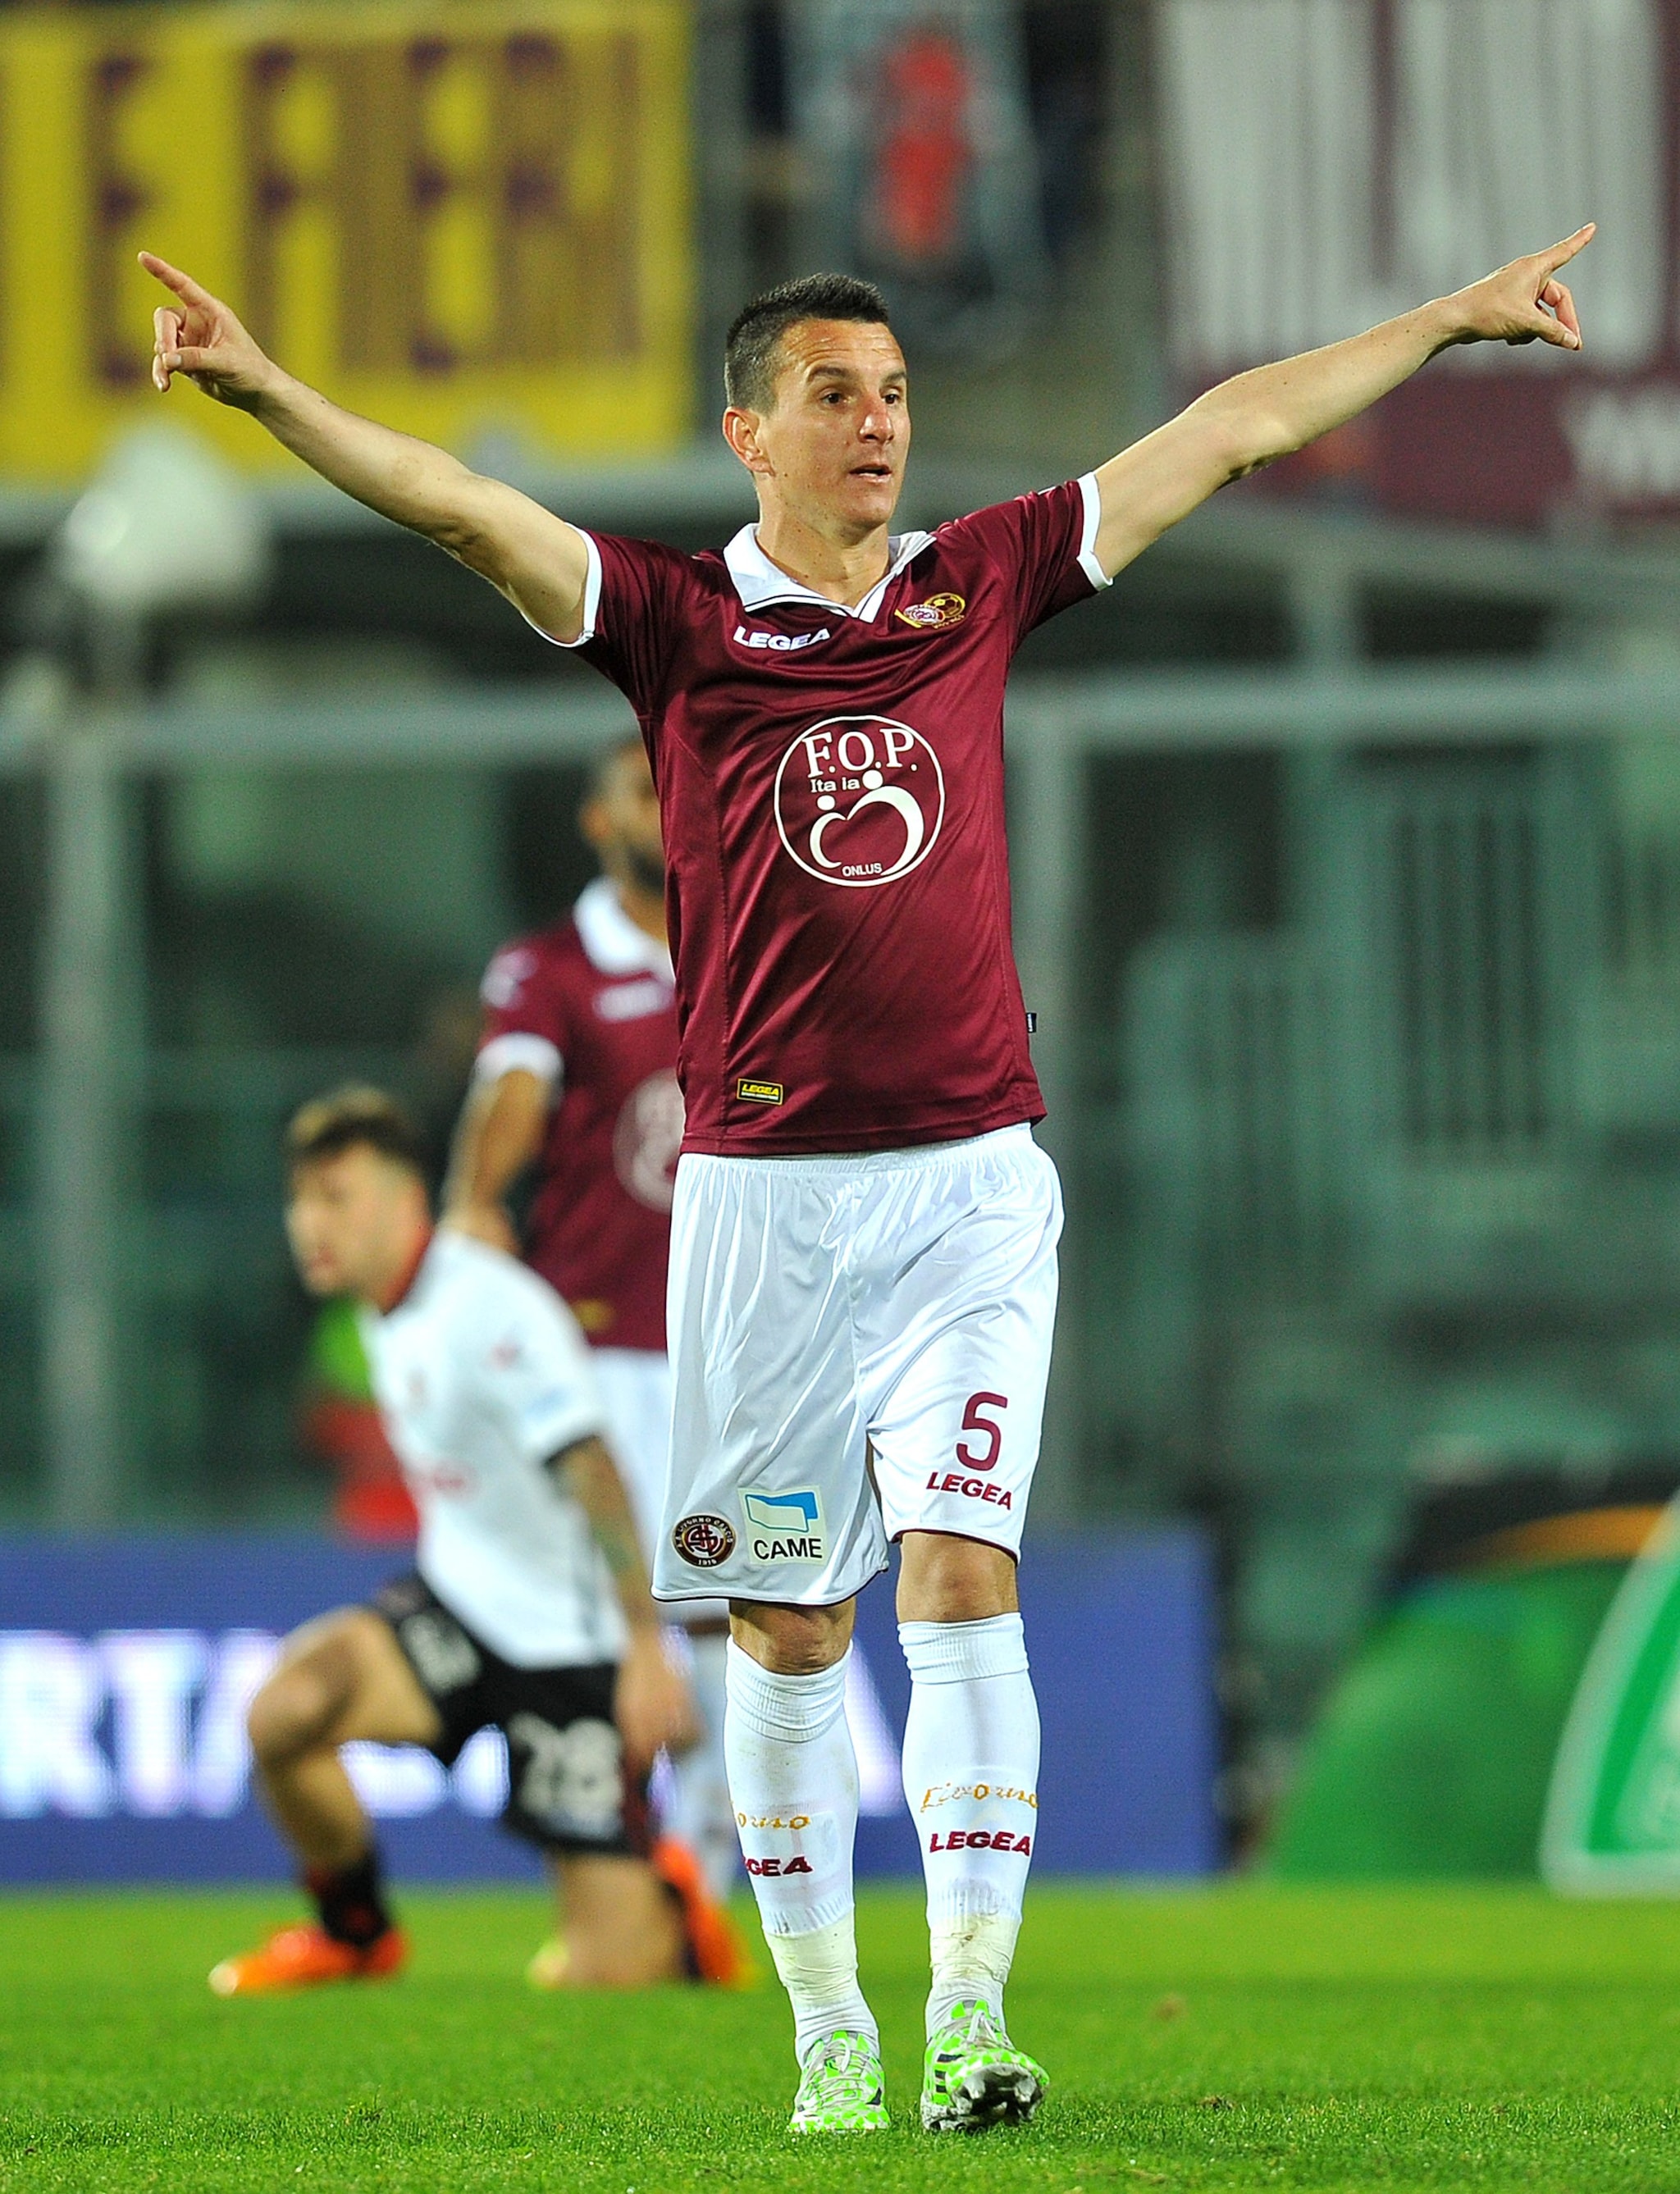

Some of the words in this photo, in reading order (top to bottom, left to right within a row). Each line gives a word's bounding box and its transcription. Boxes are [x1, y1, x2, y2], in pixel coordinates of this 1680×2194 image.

[733, 625, 830, 650] LEGEA
[801, 728, 918, 778] F.O.P.
[842, 862, 883, 877] ONLUS
[742, 1083, 779, 1096] LEGEA
[956, 1391, 1007, 1471] 5
[926, 1472, 1012, 1510] LEGEA
[754, 1538, 823, 1560] CAME
[929, 1831, 1031, 1857] LEGEA
[742, 1855, 814, 1877] GEA
